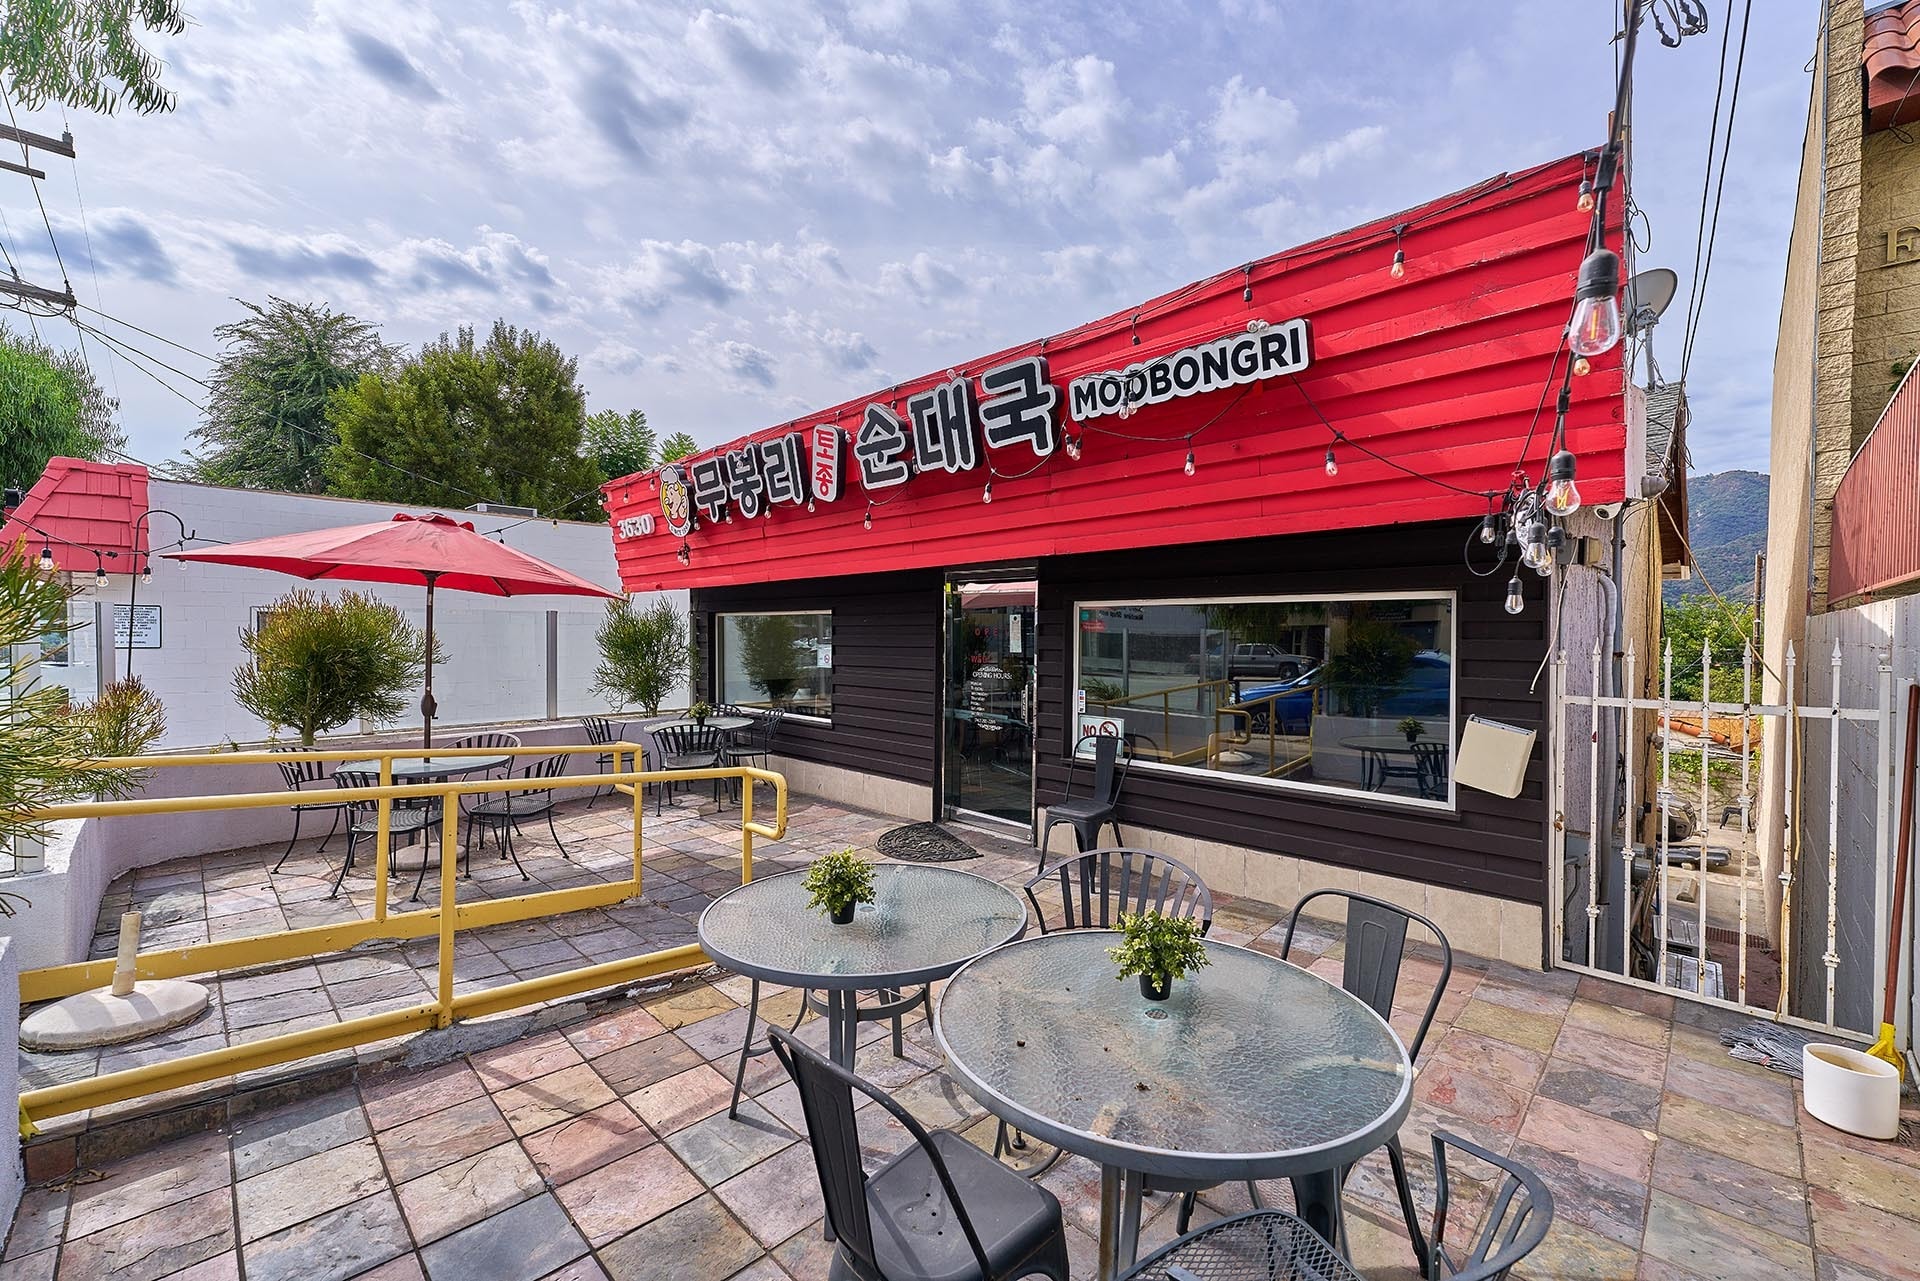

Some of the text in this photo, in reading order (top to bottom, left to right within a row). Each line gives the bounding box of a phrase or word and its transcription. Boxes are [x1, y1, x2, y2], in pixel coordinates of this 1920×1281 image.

[1073, 327, 1301, 415] MOOBONGRI
[693, 357, 1054, 524] 무봉리 토종 순대국
[618, 515, 650, 539] 3630
[1082, 724, 1097, 736] NO
